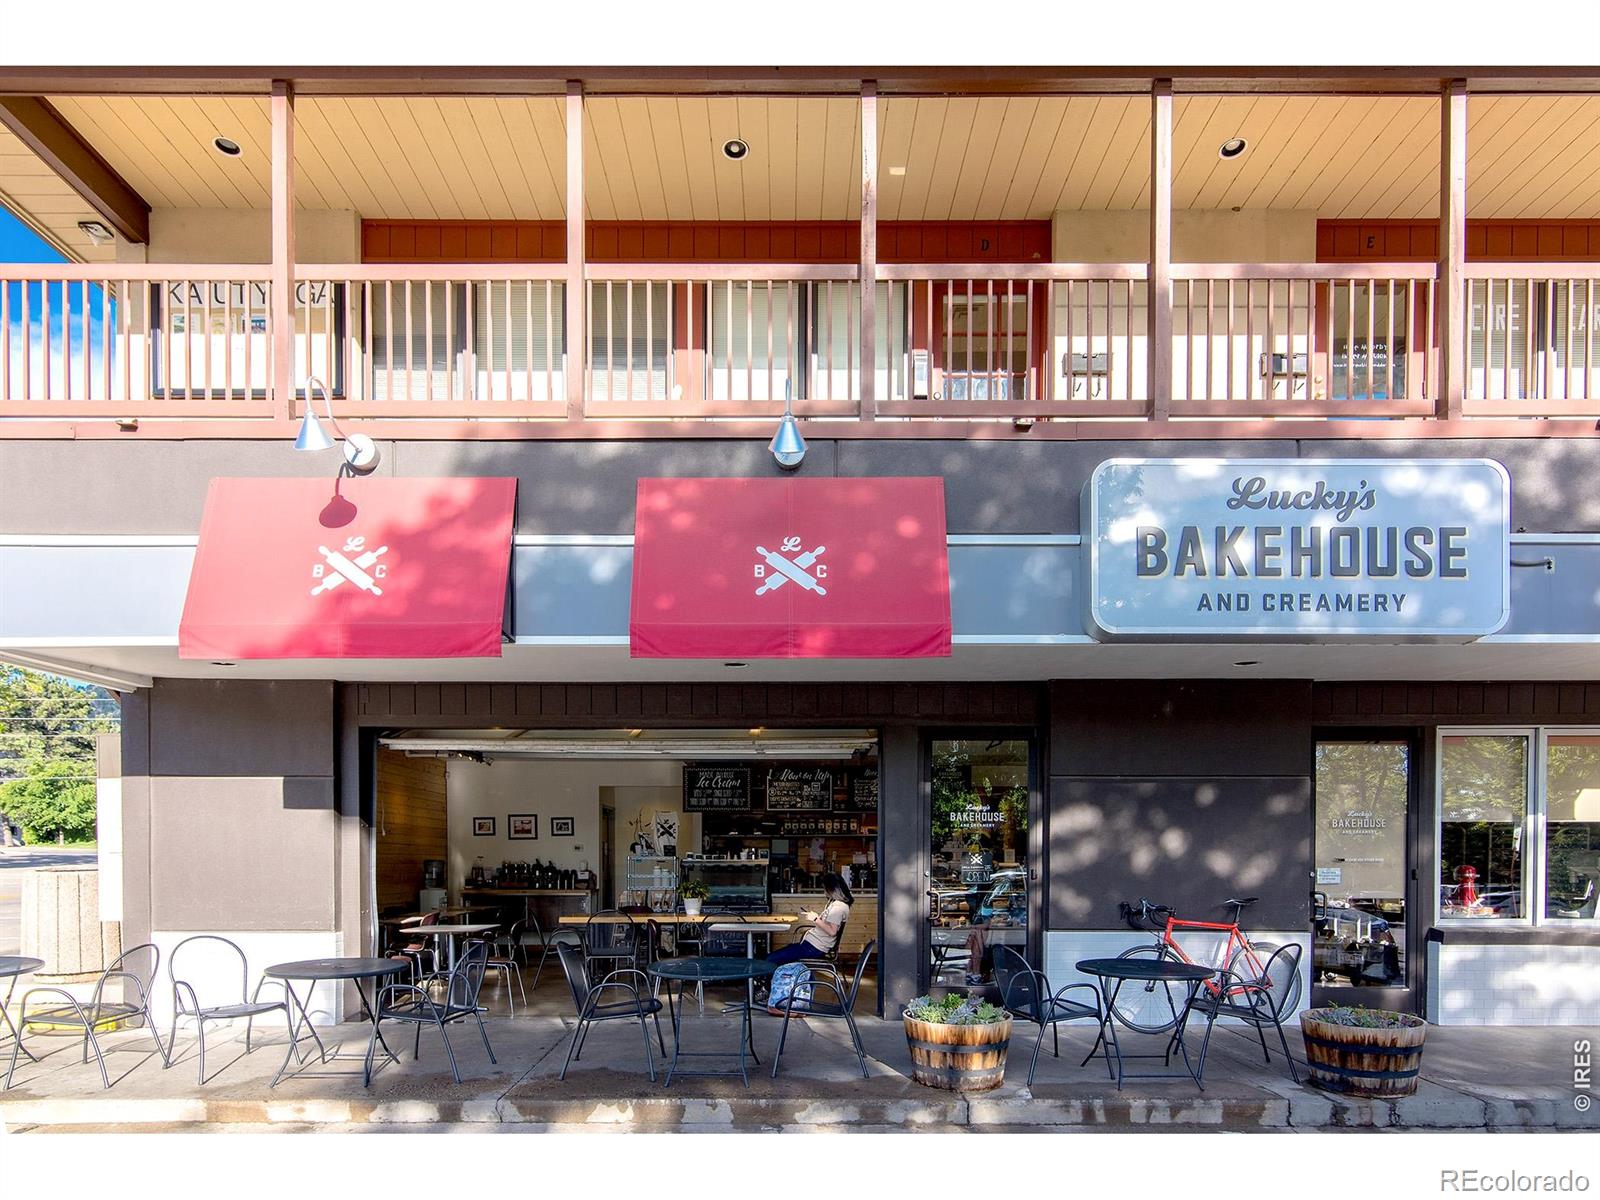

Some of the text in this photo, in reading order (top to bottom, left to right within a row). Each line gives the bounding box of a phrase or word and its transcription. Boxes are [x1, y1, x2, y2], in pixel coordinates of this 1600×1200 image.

[981, 239, 990, 251] D
[1366, 235, 1376, 249] E
[1226, 476, 1376, 523] Lucky's
[1136, 525, 1469, 579] BAKEHOUSE
[312, 564, 387, 578] B C
[754, 564, 828, 578] B C
[1197, 593, 1406, 612] AND CREAMERY
[949, 811, 1005, 822] BAKEHOUSE
[1332, 819, 1386, 828] BAKEHOUSE
[967, 871, 991, 882] OPEN
